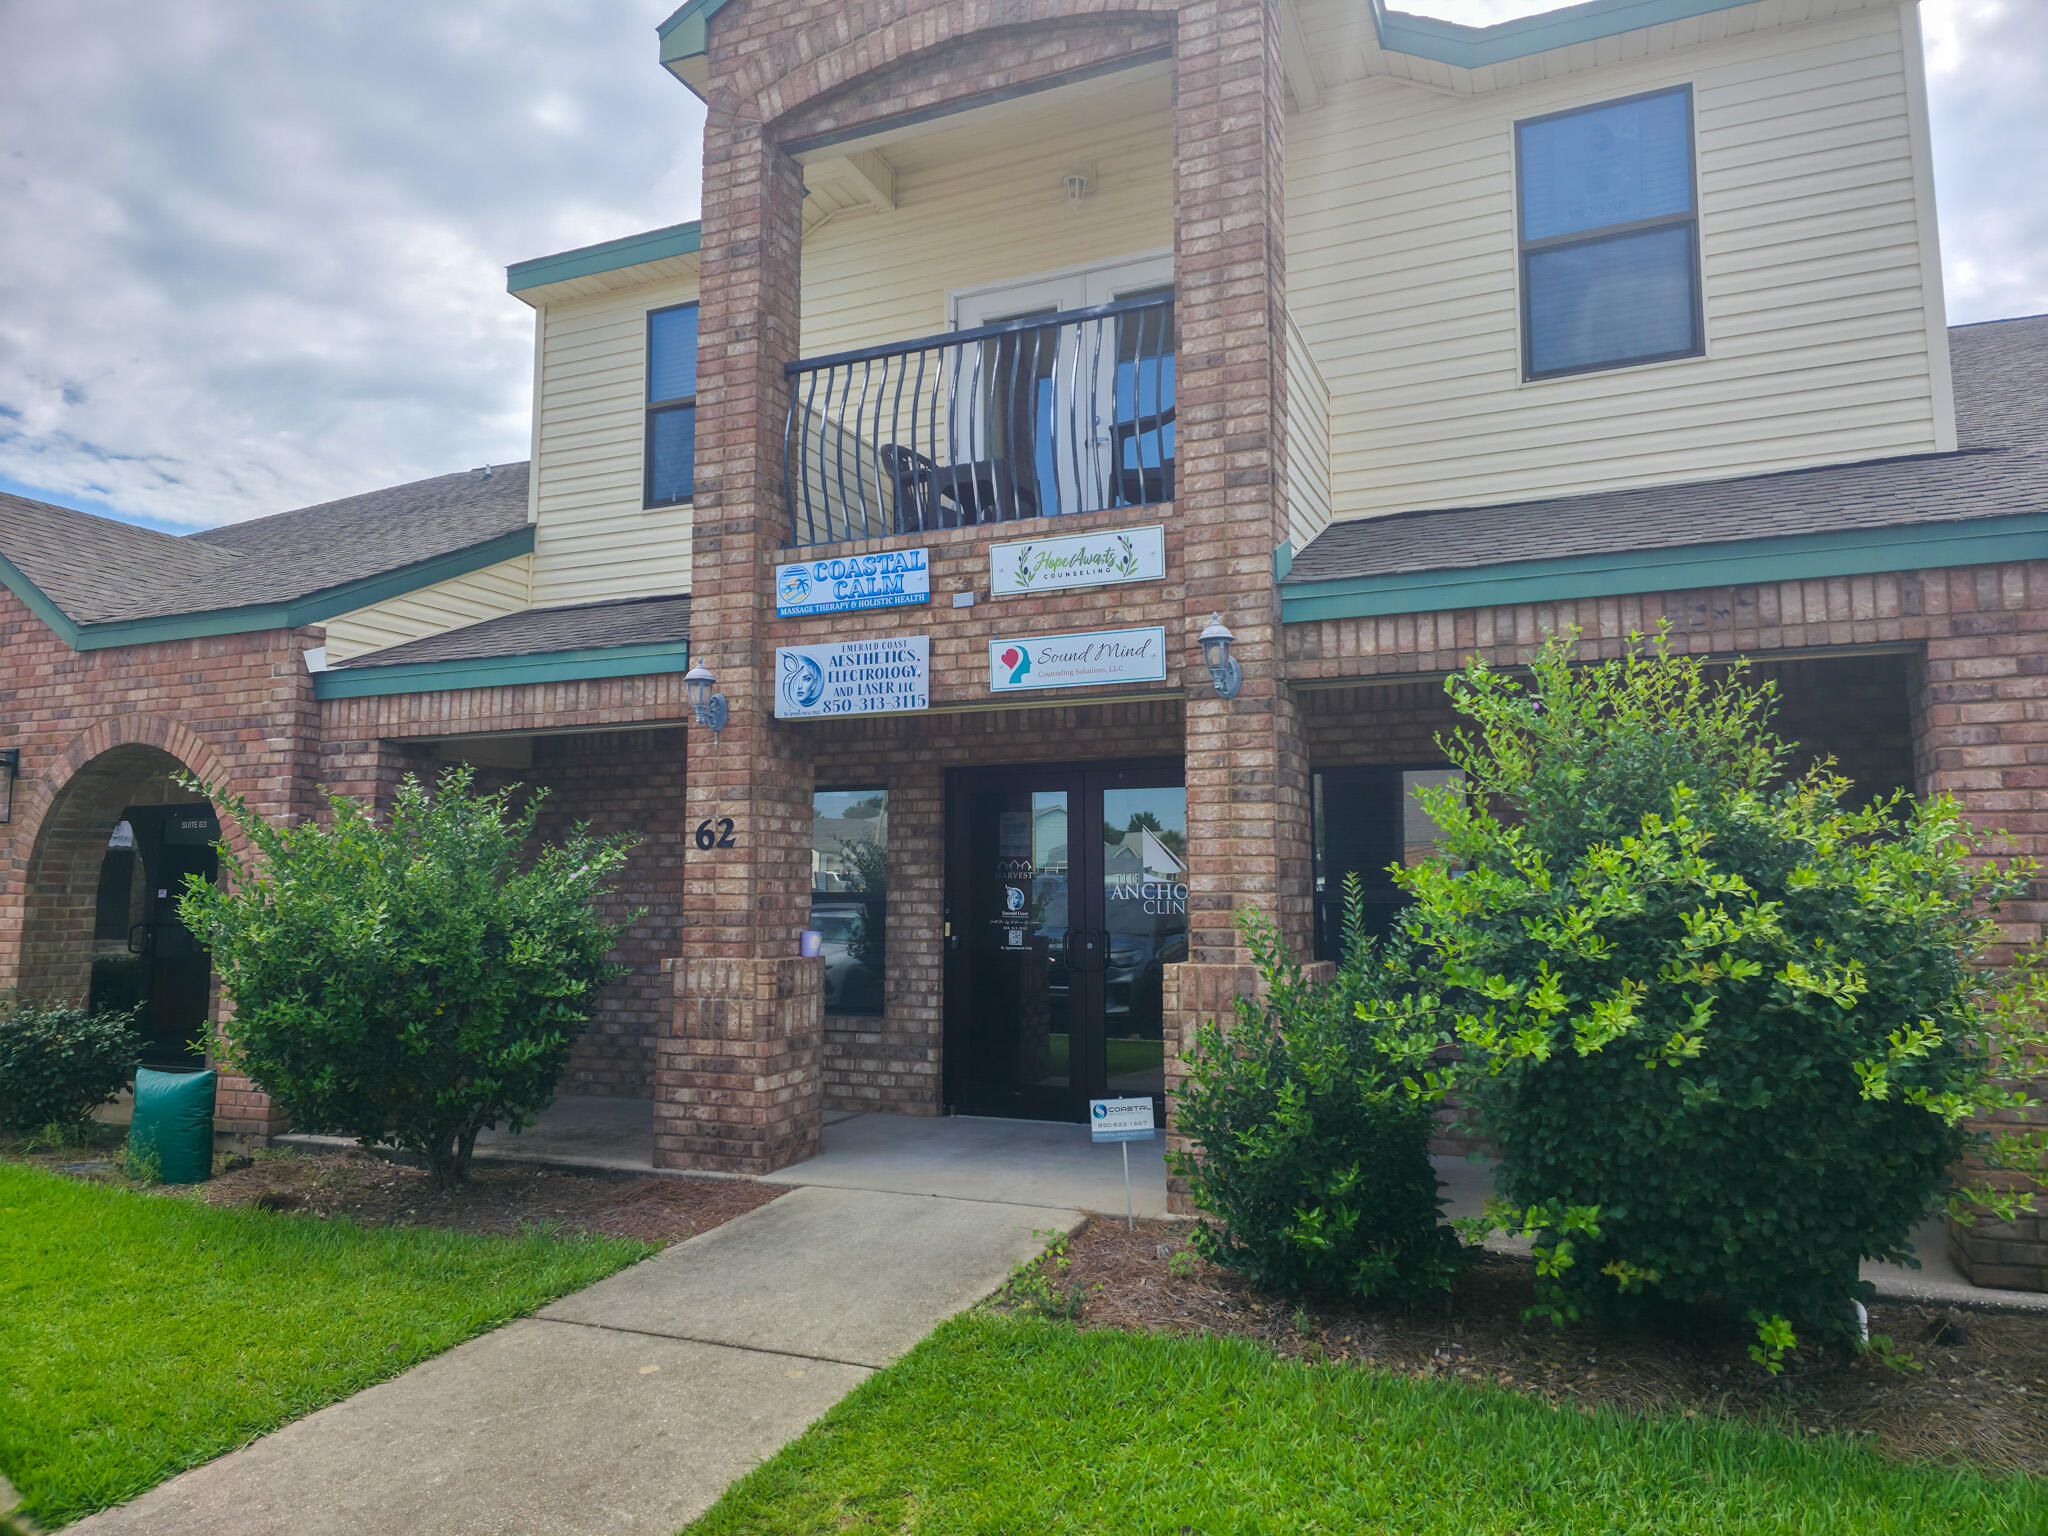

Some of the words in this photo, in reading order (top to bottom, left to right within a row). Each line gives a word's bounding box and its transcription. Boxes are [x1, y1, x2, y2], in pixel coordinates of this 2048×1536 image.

[813, 550, 926, 582] COASTAL
[1043, 567, 1111, 580] COUNSELING
[833, 574, 905, 600] CALM
[780, 605, 814, 616] MASSAGE
[815, 601, 850, 613] THERAPY
[851, 600, 857, 609] &
[858, 596, 894, 607] HOLISTIC
[894, 593, 925, 604] HEALTH
[842, 641, 879, 653] EMERALD
[881, 639, 907, 649] COAST
[1037, 643, 1094, 665] Sound
[1094, 638, 1152, 661] Mind
[829, 649, 921, 668] AESTHETICS,
[828, 664, 921, 683] ELECTROLOGY,
[1037, 668, 1074, 679] Counseling
[1075, 666, 1108, 677] Solutions,
[1109, 664, 1123, 673] LLC
[834, 685, 853, 697] AND
[858, 682, 894, 696] LASER
[823, 694, 926, 713] 850-313-3115
[181, 821, 198, 829] SUITE
[696, 817, 736, 851] 62
[1116, 873, 1140, 885] THE
[1107, 1105, 1151, 1113] COASTAL
